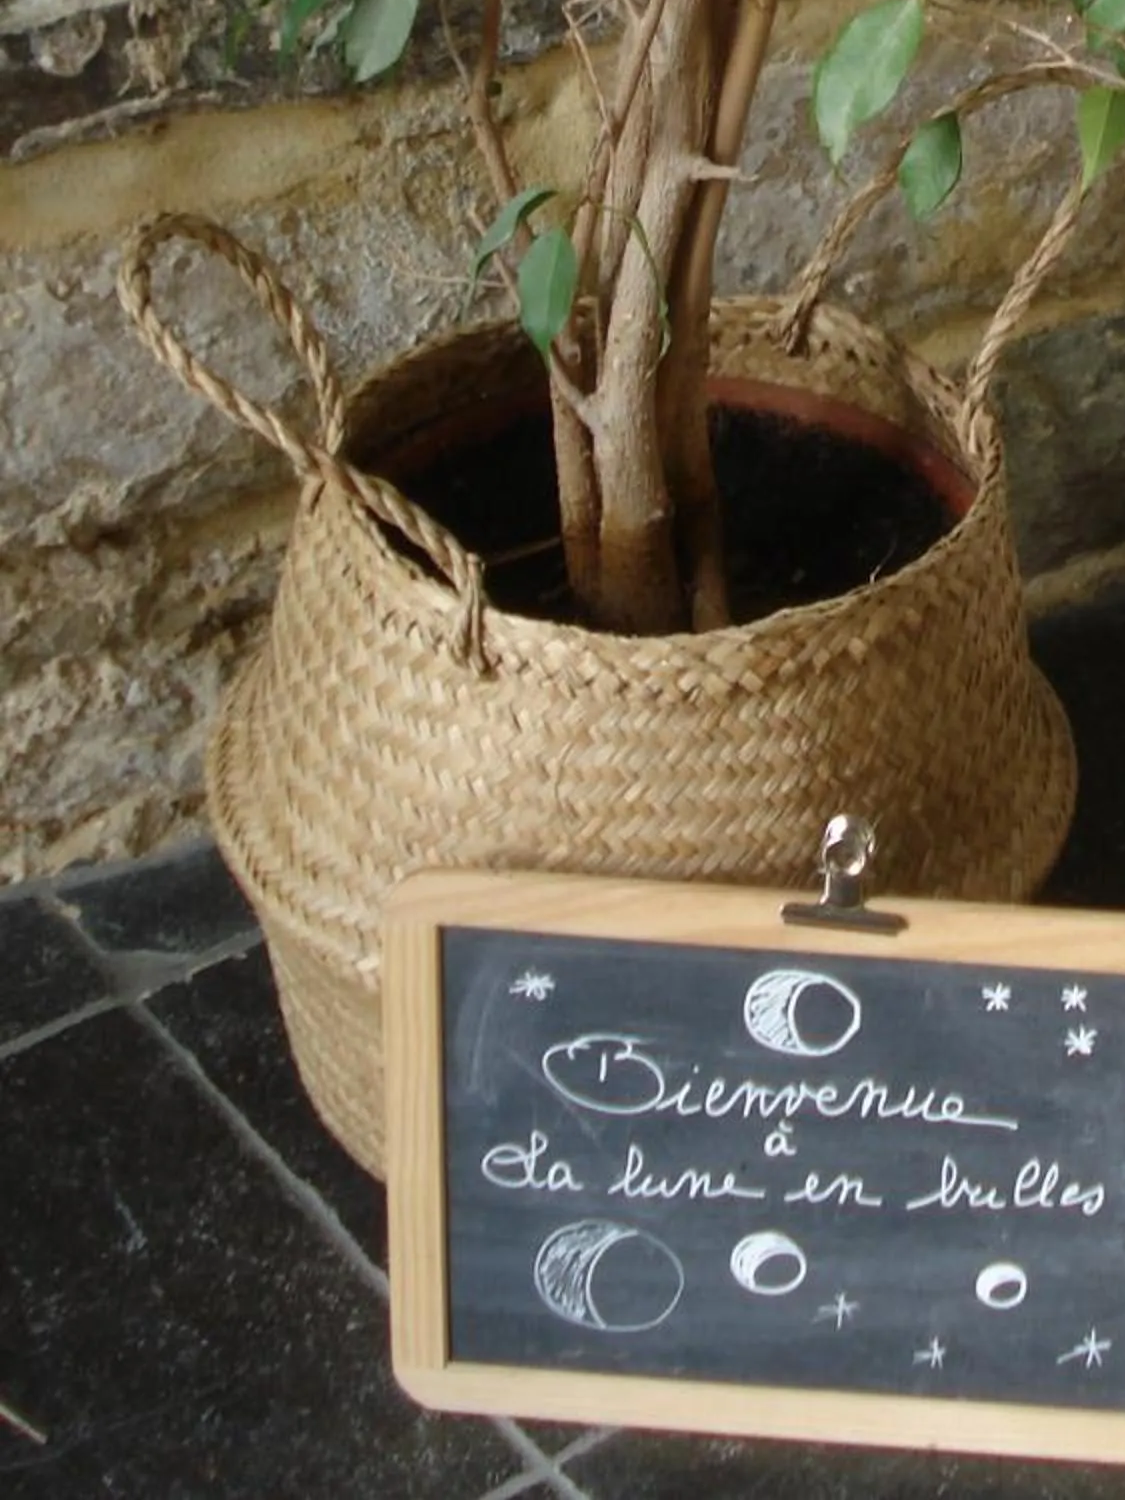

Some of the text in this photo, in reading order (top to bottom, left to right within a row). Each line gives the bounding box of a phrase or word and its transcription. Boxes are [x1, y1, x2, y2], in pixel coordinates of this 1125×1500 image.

[541, 1032, 1018, 1131] Bienvenue
[481, 1139, 1106, 1216] La lune en bulles
[763, 1122, 797, 1157] à
